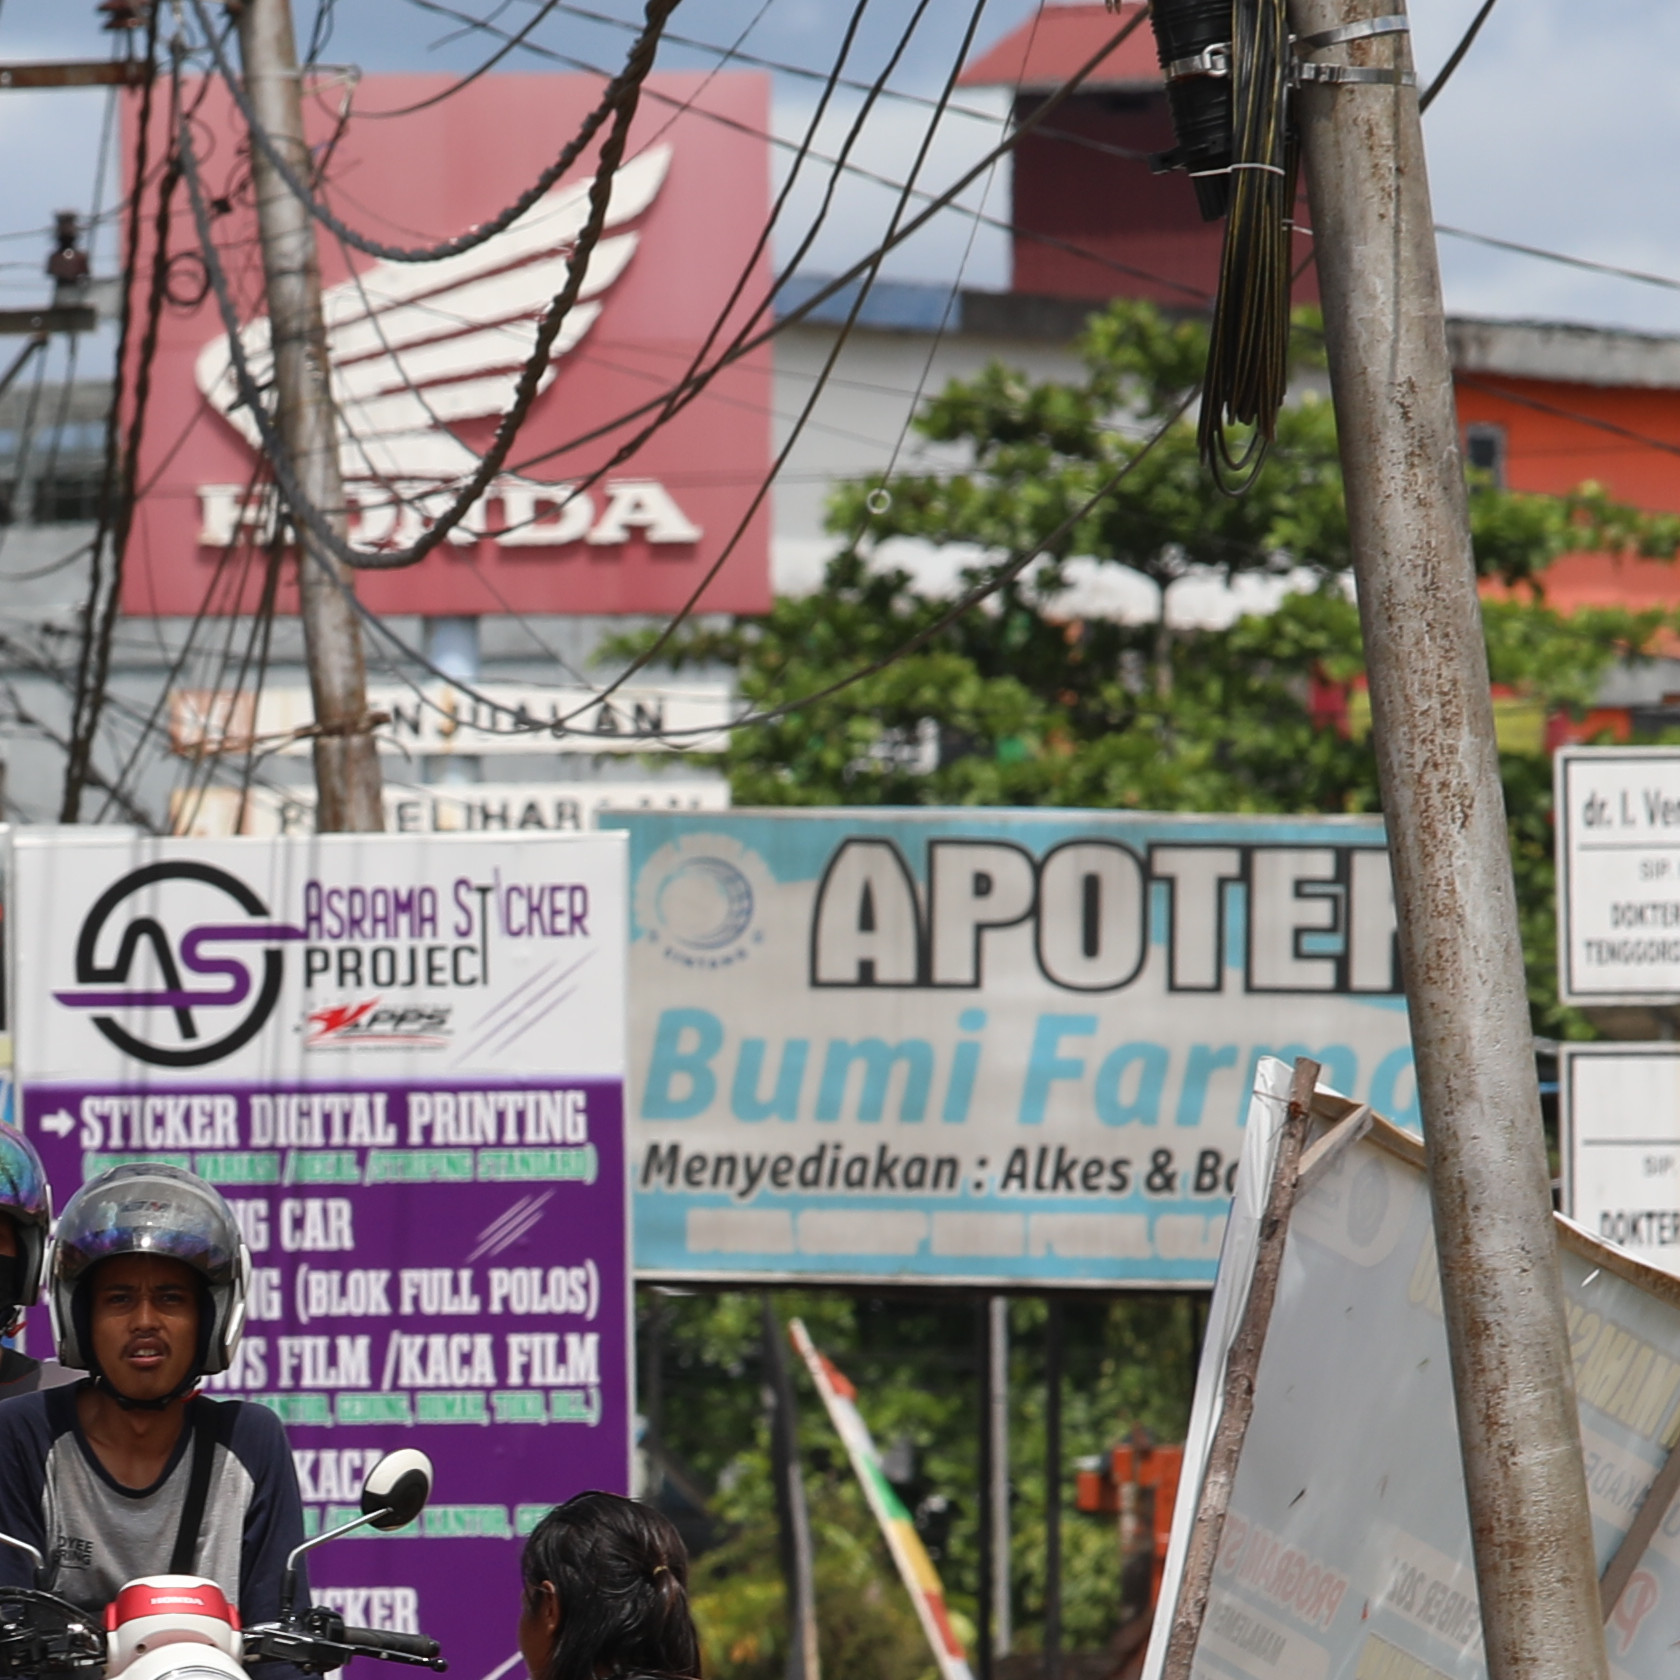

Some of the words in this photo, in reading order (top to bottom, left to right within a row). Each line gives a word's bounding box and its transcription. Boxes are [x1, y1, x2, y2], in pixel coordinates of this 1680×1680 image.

[1584, 794, 1612, 827] dr.
[304, 880, 438, 940] ASRAMA
[643, 1007, 988, 1125] Bumi
[80, 1096, 238, 1151] STICKER
[251, 1093, 397, 1149] DIGITAL
[408, 1090, 586, 1146] PRINTING
[643, 1141, 959, 1198] Menyediakan
[1003, 1146, 1130, 1195] Alkes
[281, 1198, 353, 1251] CAR
[296, 1267, 392, 1323] (BLOK
[399, 1264, 479, 1318] FULL
[489, 1259, 599, 1320] POLOS)
[278, 1335, 372, 1389] FILM
[382, 1331, 496, 1391] /KACA
[507, 1332, 600, 1386] FILM
[150, 1593, 206, 1607] HONDA
